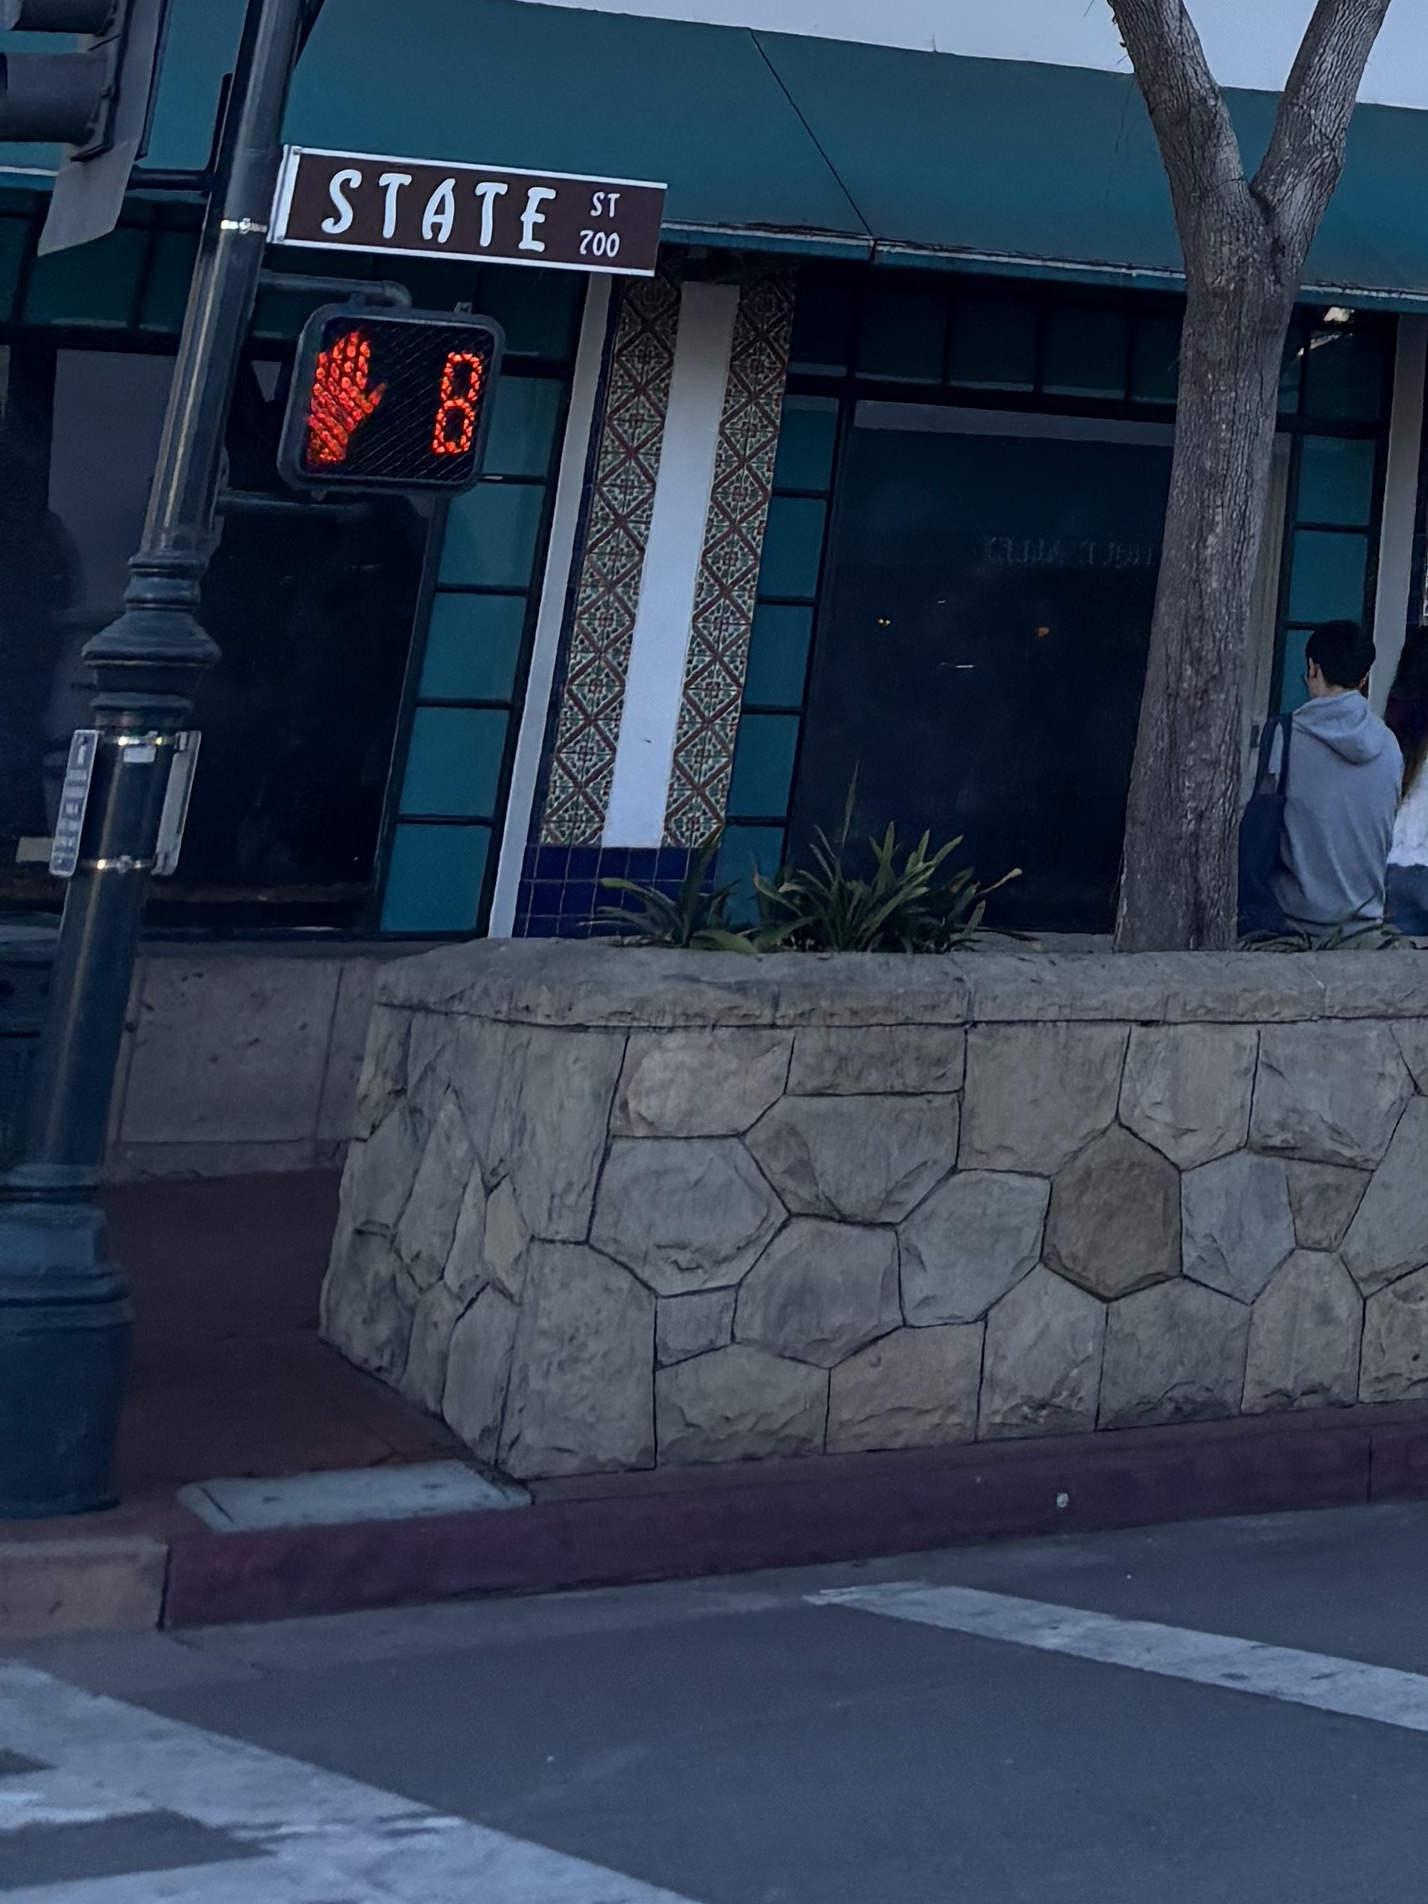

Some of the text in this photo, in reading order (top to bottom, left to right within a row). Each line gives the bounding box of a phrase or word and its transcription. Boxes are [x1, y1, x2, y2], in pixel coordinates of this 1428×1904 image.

[321, 168, 621, 253] STATE ST
[578, 229, 620, 258] 700
